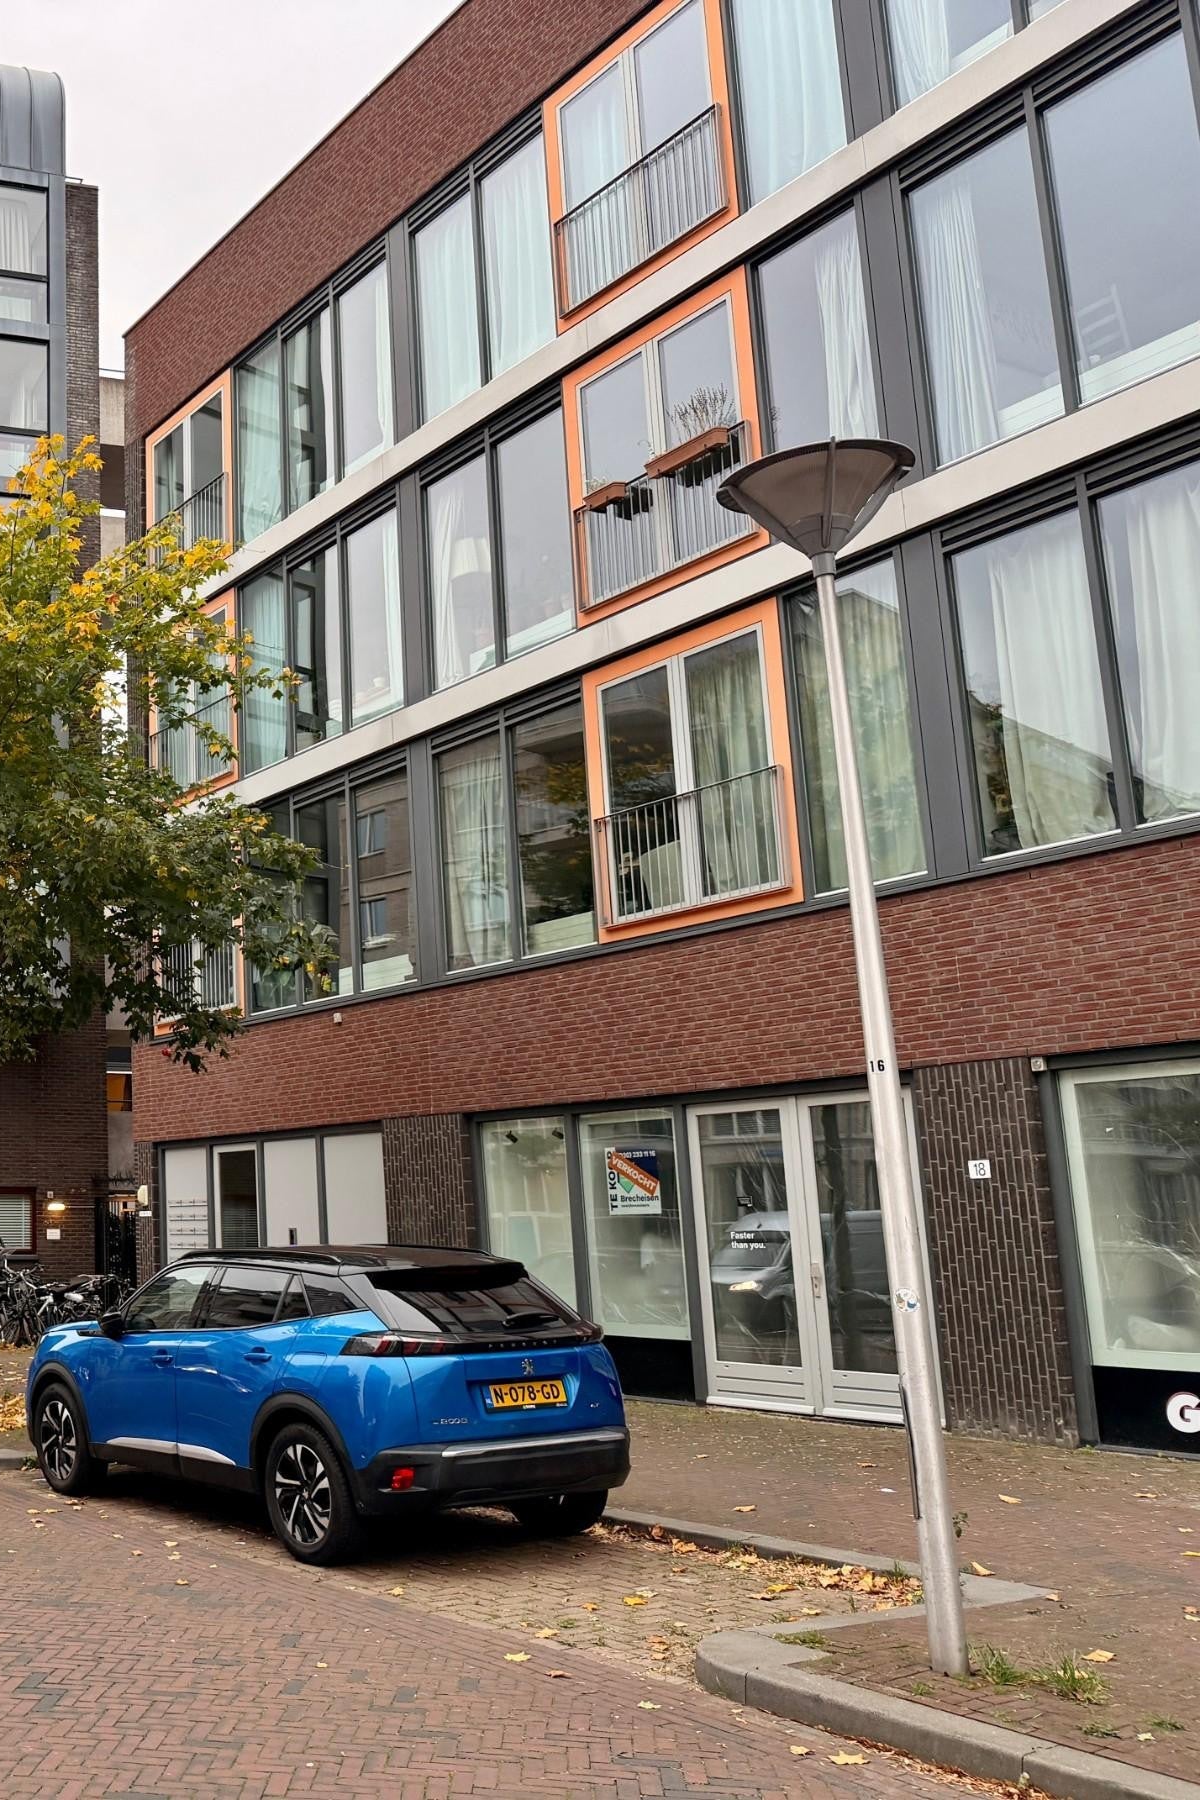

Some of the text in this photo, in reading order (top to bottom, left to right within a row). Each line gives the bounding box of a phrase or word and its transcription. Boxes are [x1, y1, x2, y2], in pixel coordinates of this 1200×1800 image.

[869, 1059, 885, 1073] 16
[611, 1155, 657, 1191] VERKOCHT
[973, 1162, 986, 1177] 18
[606, 1150, 619, 1212] TE KOP
[620, 1193, 660, 1203] Brecheisen
[730, 1231, 755, 1240] Faster
[731, 1240, 767, 1251] than you.
[492, 1383, 562, 1404] N-078-GD
[1166, 1391, 1200, 1434] G
